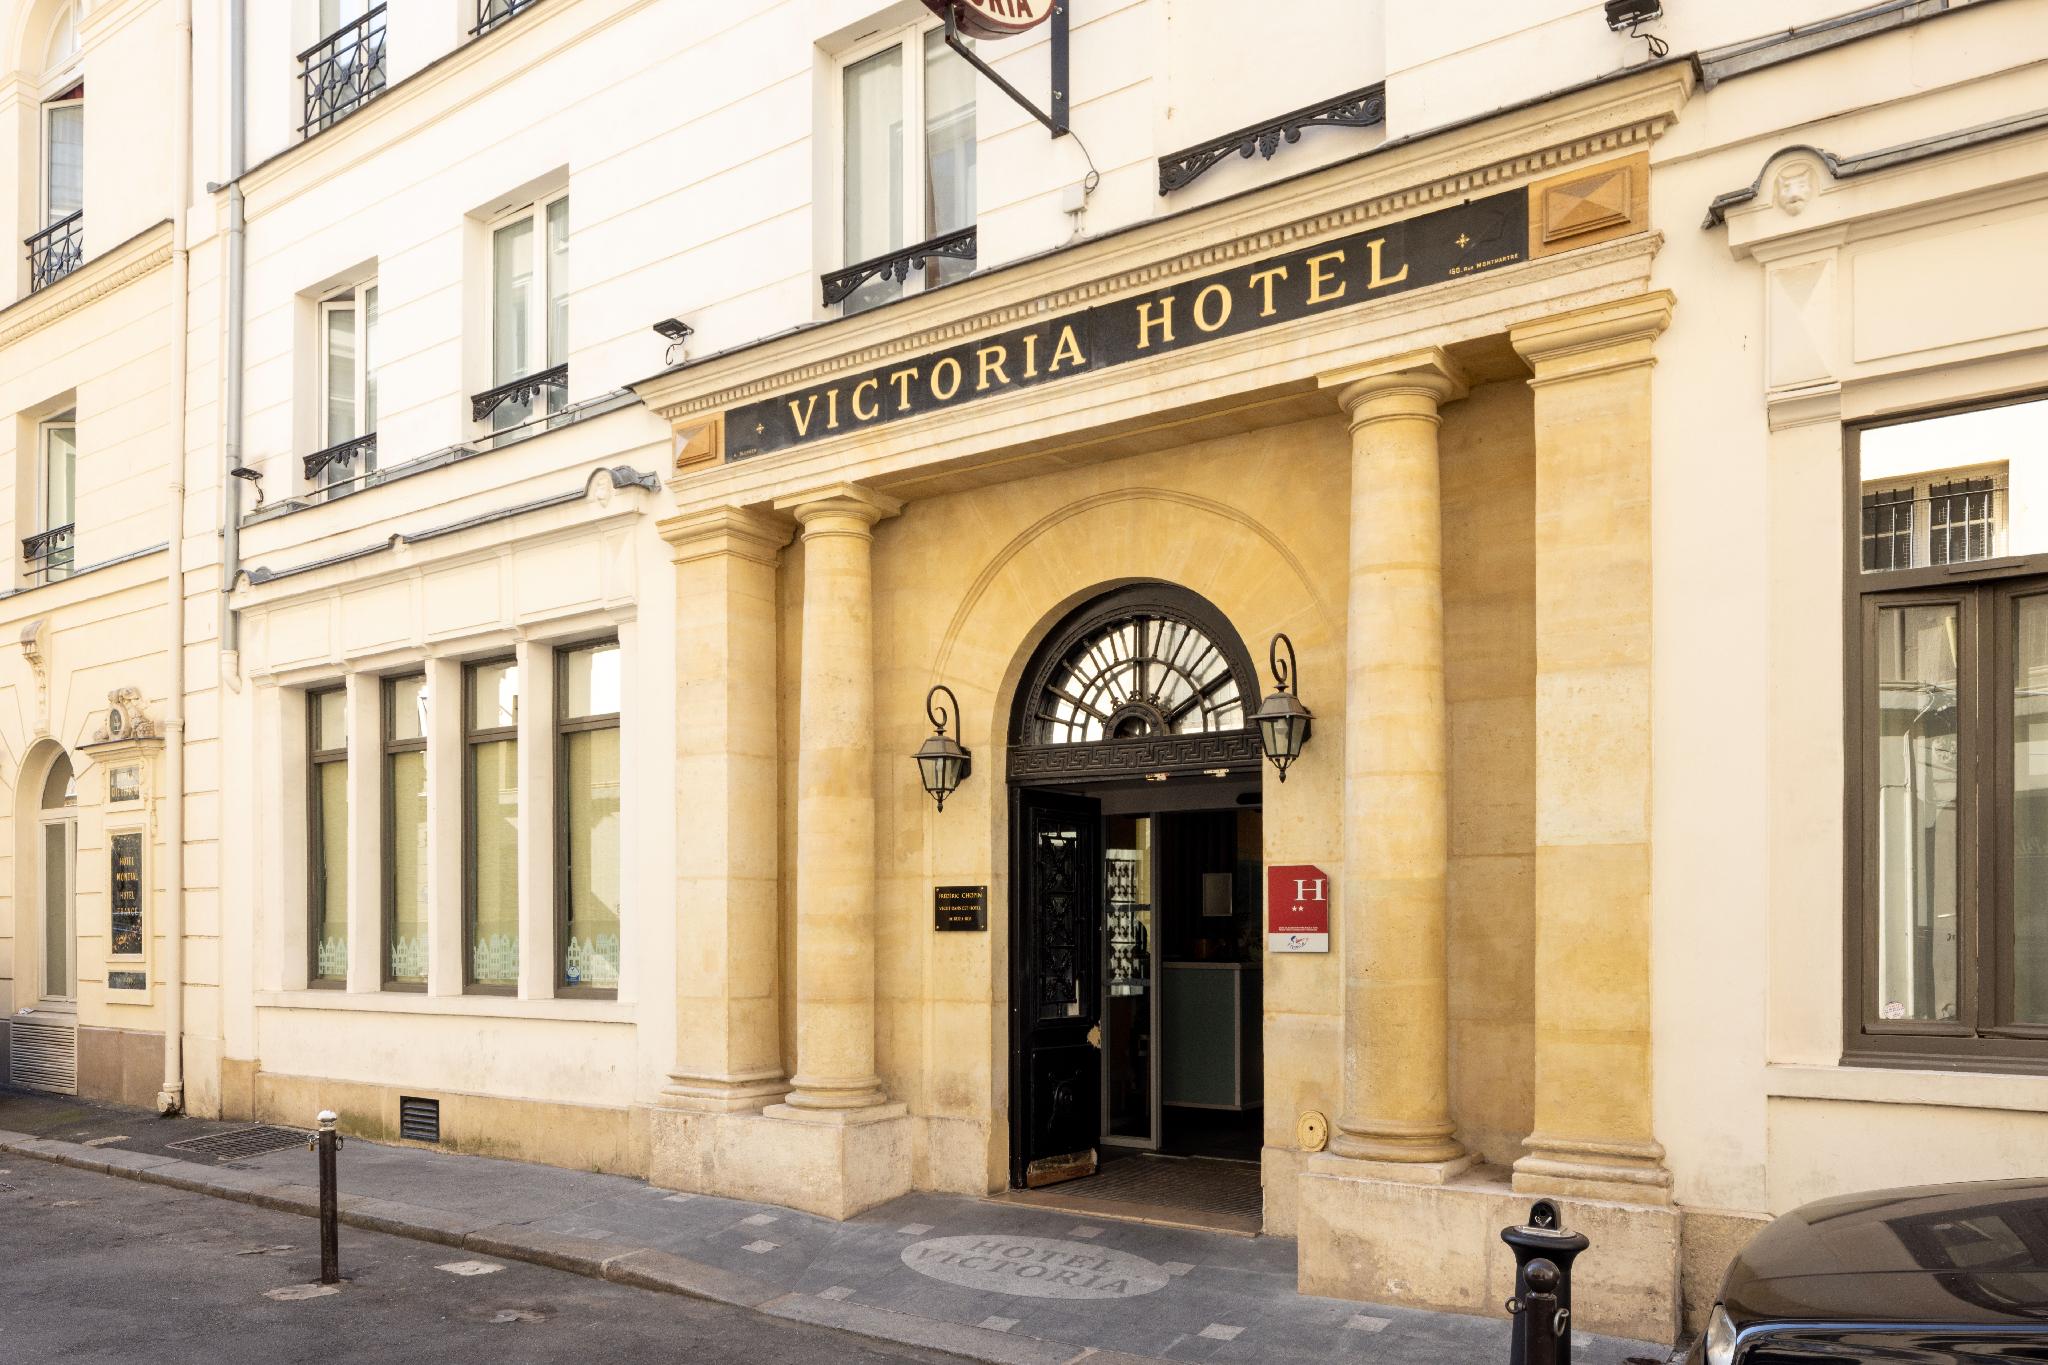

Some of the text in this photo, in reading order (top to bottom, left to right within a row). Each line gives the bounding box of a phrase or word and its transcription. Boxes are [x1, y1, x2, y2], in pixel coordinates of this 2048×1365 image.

[789, 237, 1409, 436] VICTORIA HOTEL
[1293, 879, 1327, 901] H
[917, 1248, 1130, 1295] VICTORIA
[968, 1240, 1114, 1274] HOTEL
